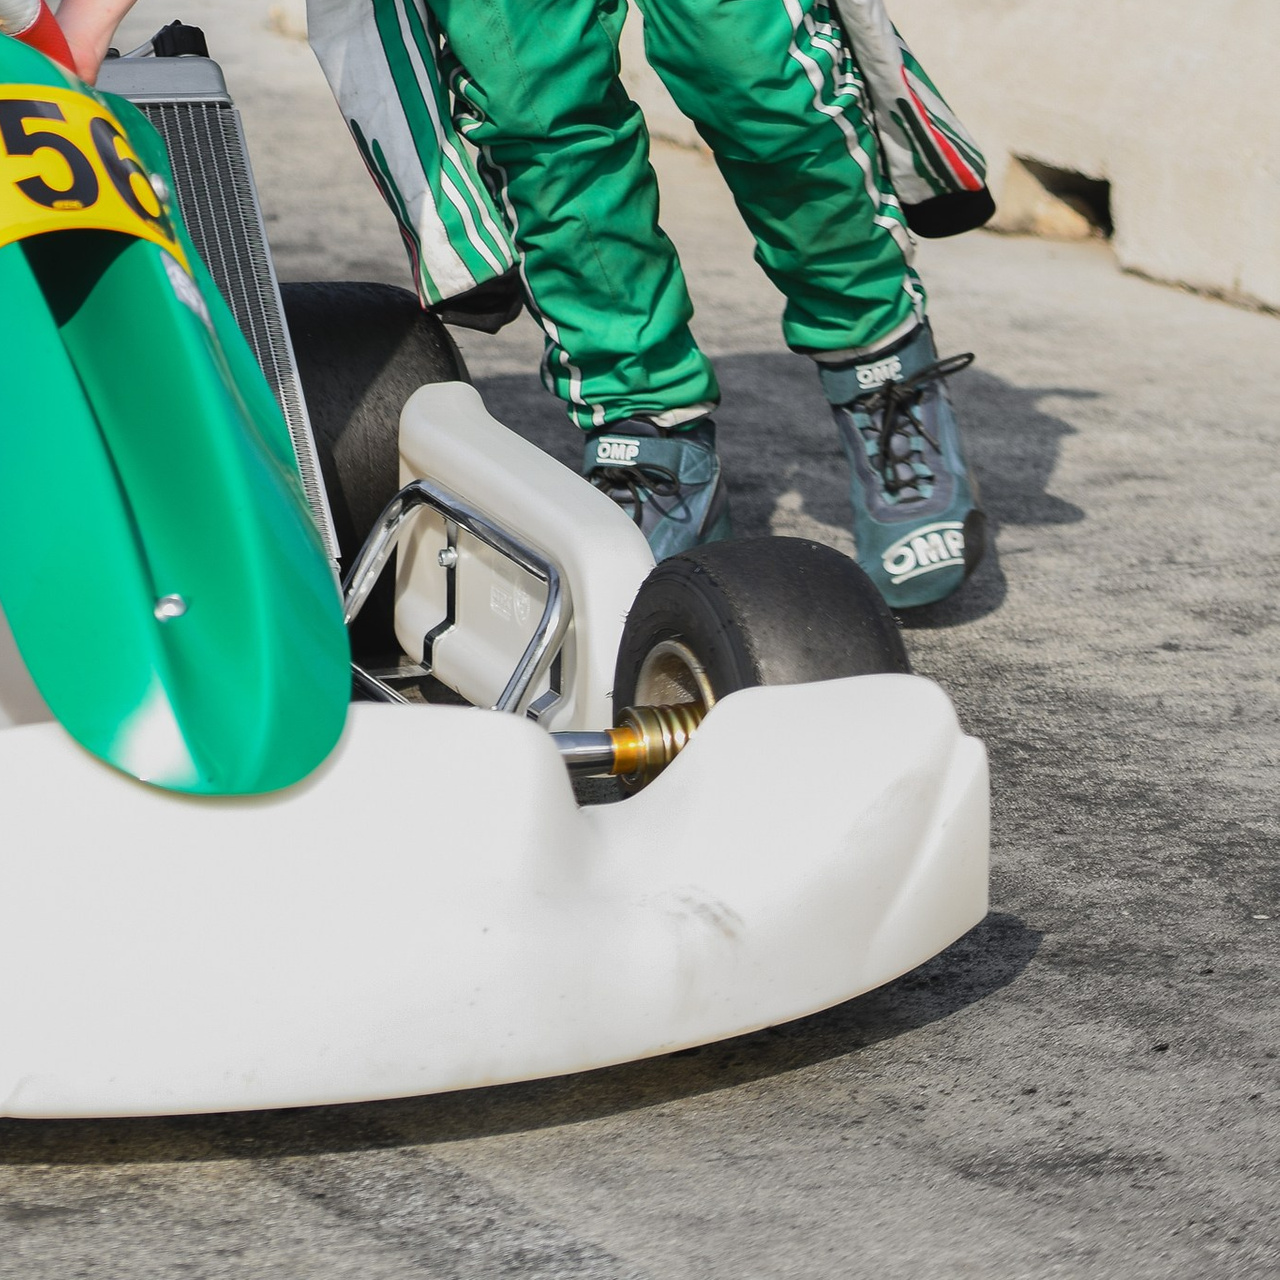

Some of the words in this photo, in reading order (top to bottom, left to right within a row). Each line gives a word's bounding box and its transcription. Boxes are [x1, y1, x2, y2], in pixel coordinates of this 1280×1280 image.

[855, 359, 903, 386] OMP
[597, 441, 640, 462] OMP
[882, 527, 965, 576] OMP
